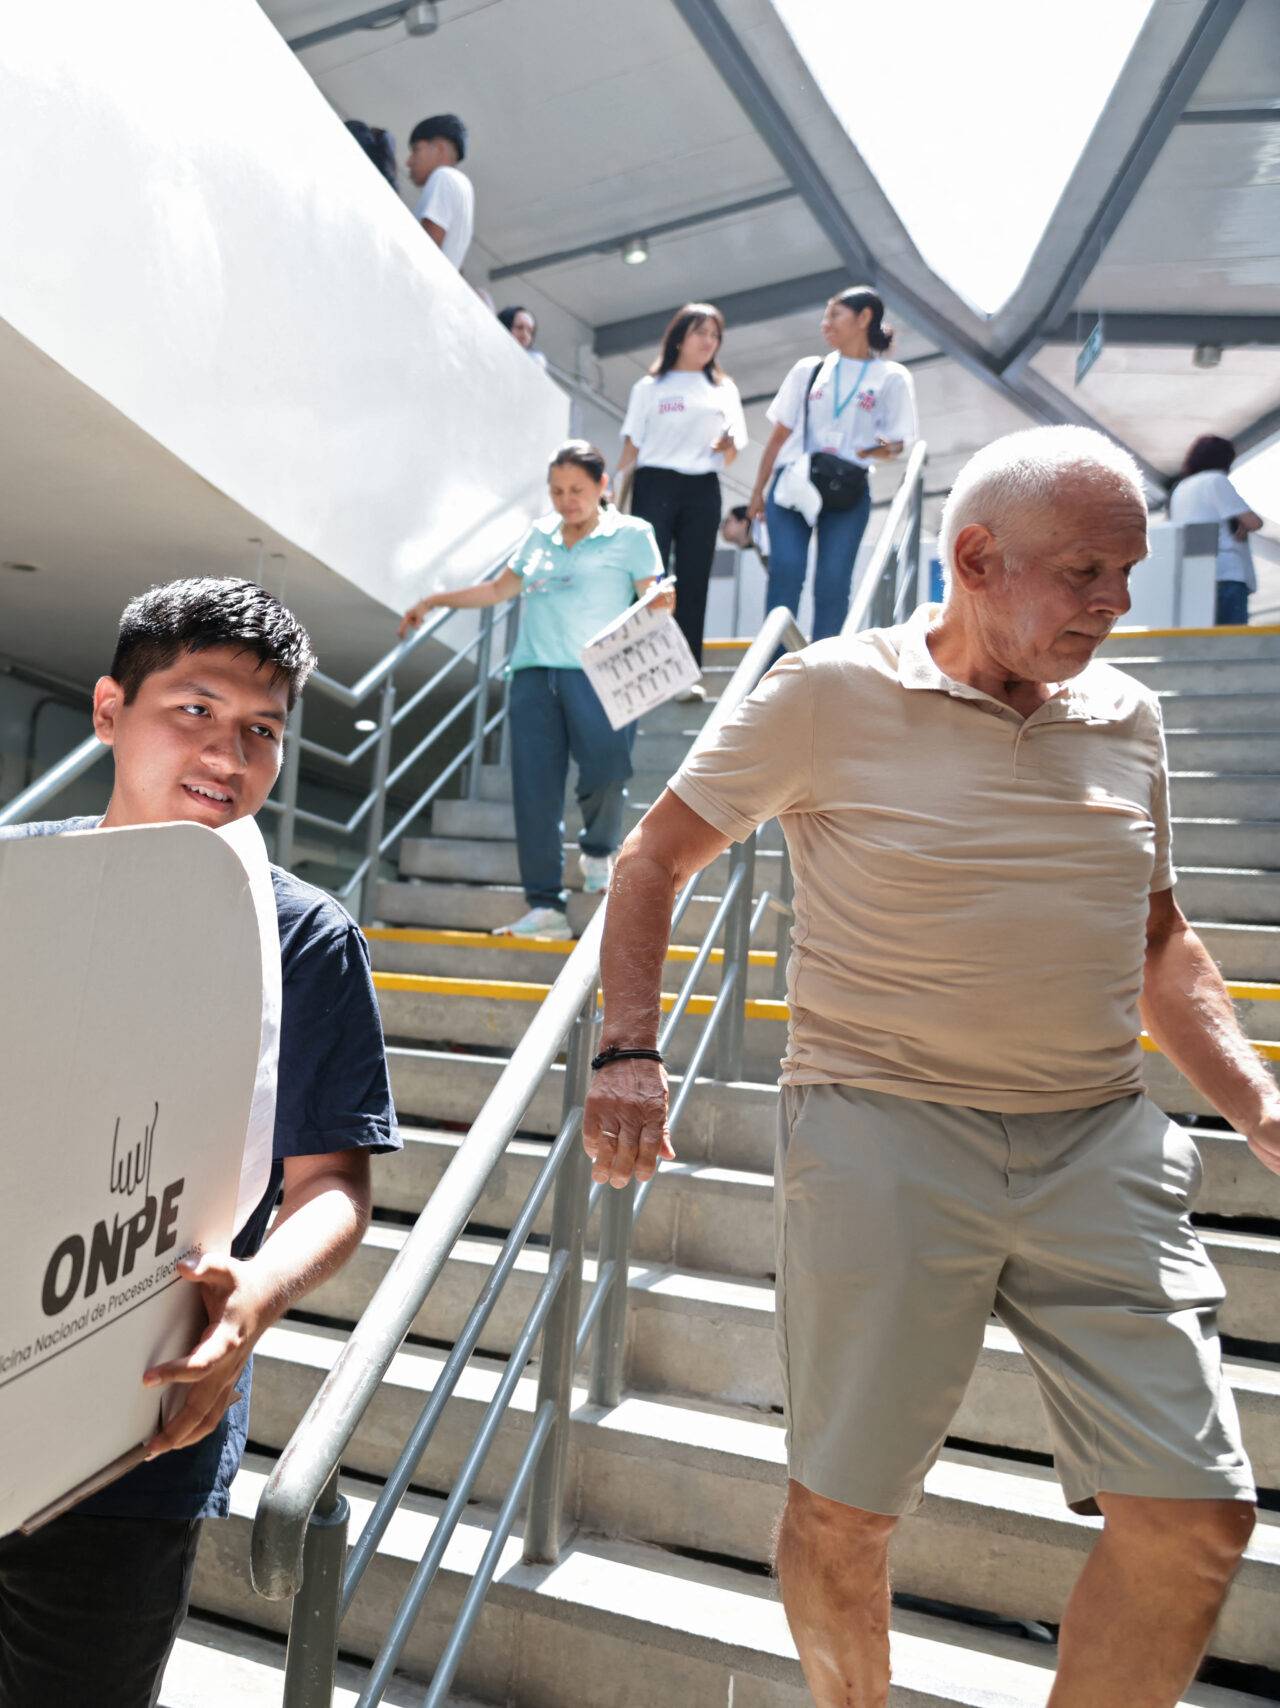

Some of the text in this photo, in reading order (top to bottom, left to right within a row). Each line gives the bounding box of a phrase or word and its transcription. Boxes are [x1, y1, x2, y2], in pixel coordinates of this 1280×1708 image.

[41, 1177, 185, 1316] ONPE
[33, 1309, 90, 1356] Nacional
[90, 1303, 106, 1322] de
[107, 1273, 154, 1313] Procesos
